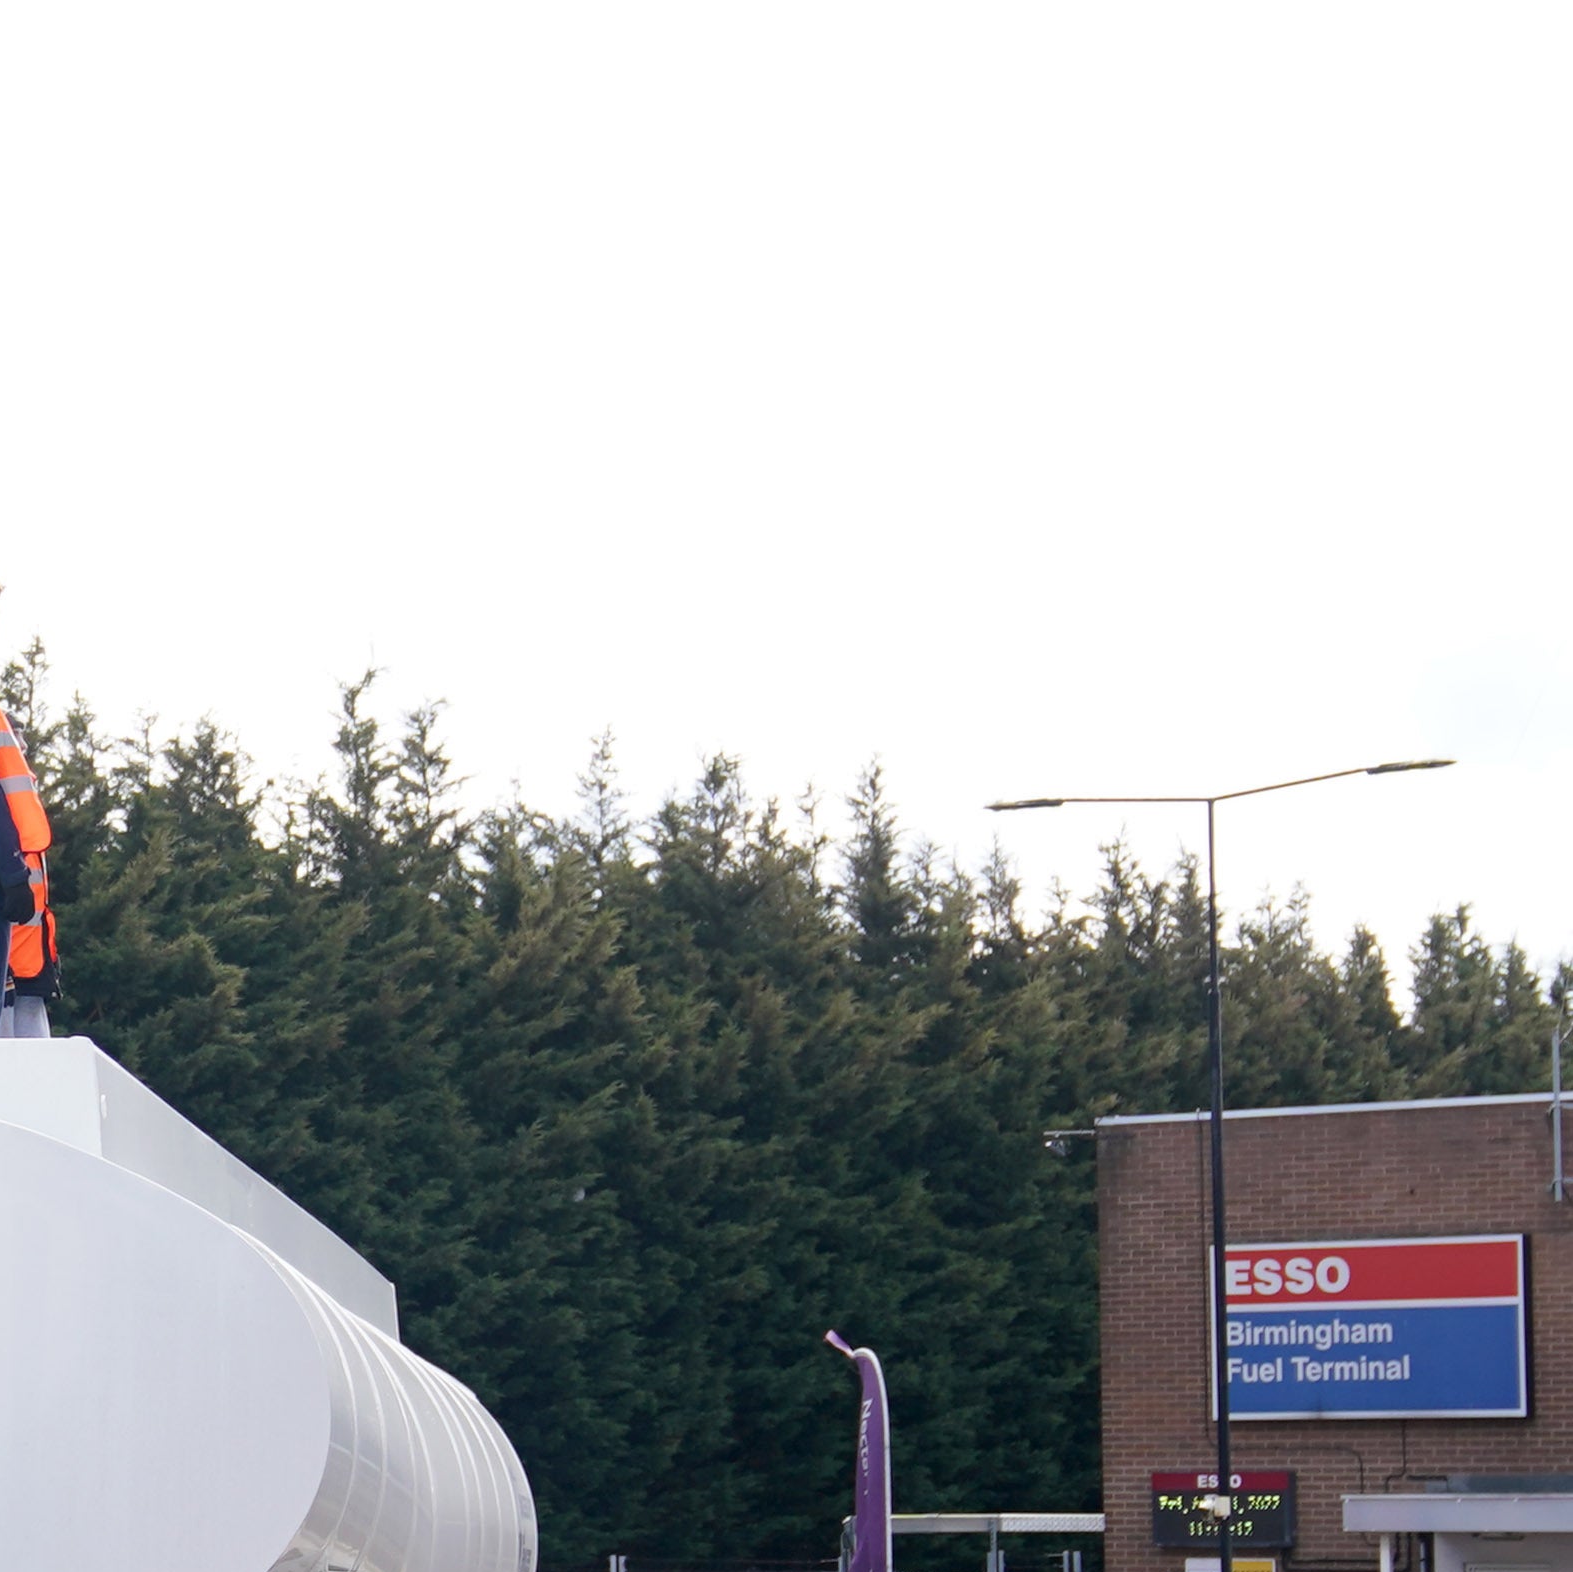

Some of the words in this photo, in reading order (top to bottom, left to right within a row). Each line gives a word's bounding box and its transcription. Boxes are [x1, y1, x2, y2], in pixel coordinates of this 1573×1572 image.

[1225, 1256, 1351, 1295] ESSO
[1226, 1319, 1393, 1351] Birmingham
[1227, 1358, 1283, 1383] Fuel
[1291, 1355, 1410, 1382] Terminal
[1197, 1474, 1242, 1489] ESO
